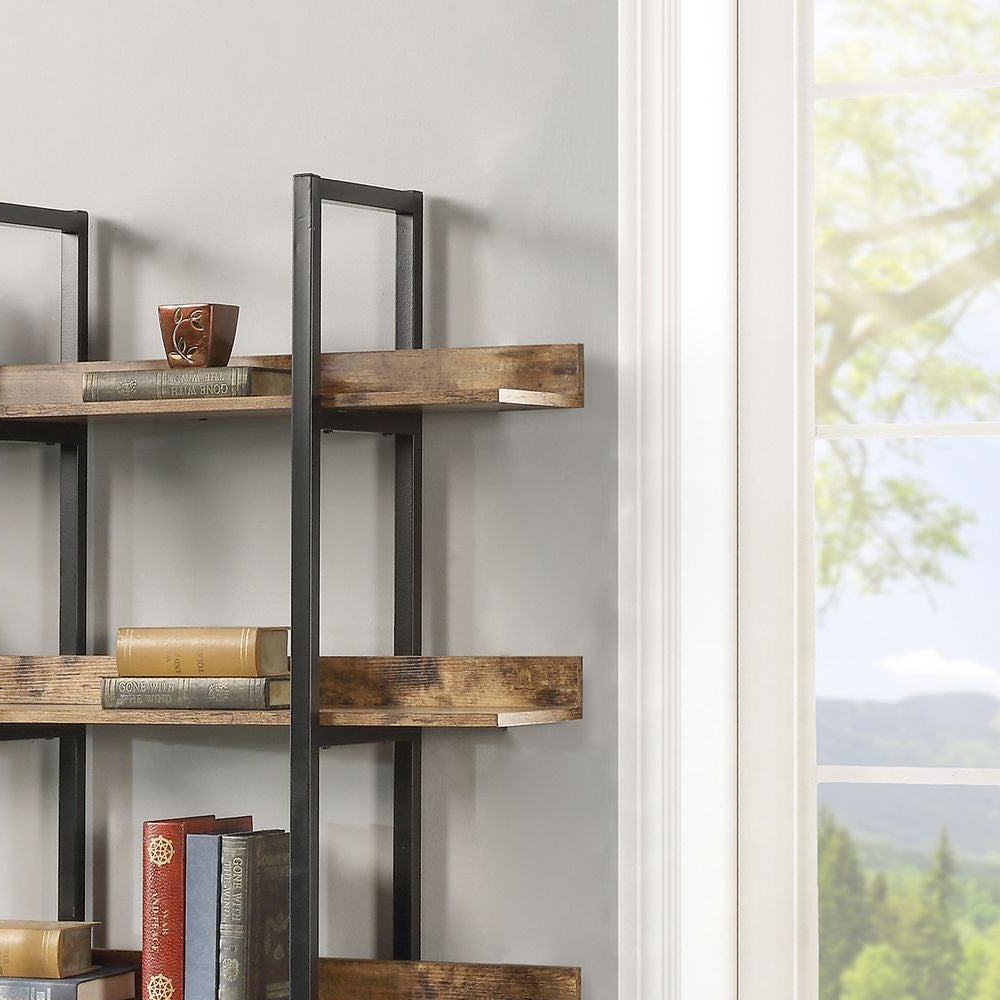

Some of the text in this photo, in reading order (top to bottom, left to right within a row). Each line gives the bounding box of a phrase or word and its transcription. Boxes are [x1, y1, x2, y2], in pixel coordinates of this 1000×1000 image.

[171, 383, 228, 396] GONE WITH
[118, 680, 175, 692] GONE WITH
[121, 694, 172, 705] THE WIND
[223, 861, 232, 918] THE WIND
[231, 857, 243, 921] GONE WITH
